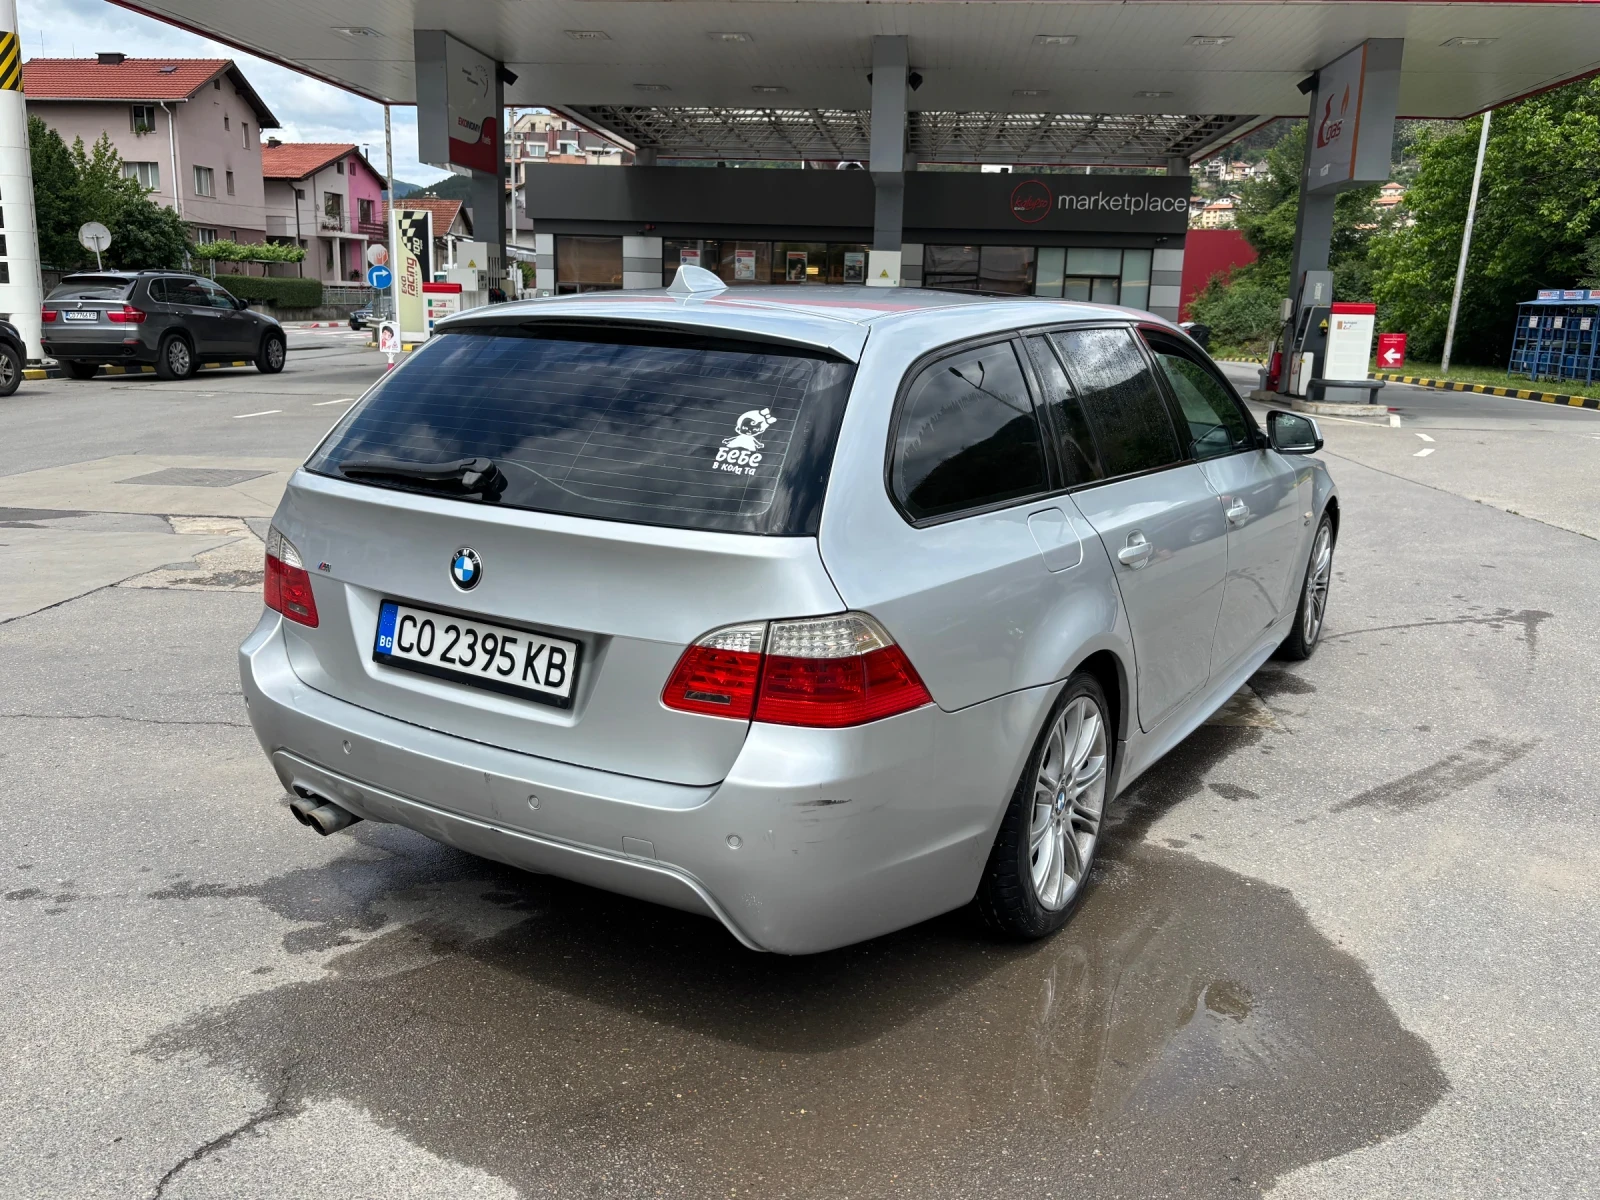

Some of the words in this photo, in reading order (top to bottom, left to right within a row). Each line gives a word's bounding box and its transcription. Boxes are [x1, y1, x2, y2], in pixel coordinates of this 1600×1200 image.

[458, 116, 480, 133] EKONOMY
[1057, 191, 1187, 215] marketplace
[407, 257, 417, 297] racing
[379, 634, 393, 649] BG
[397, 614, 436, 658] CO
[439, 624, 518, 676] 2395
[521, 640, 568, 689] KB
